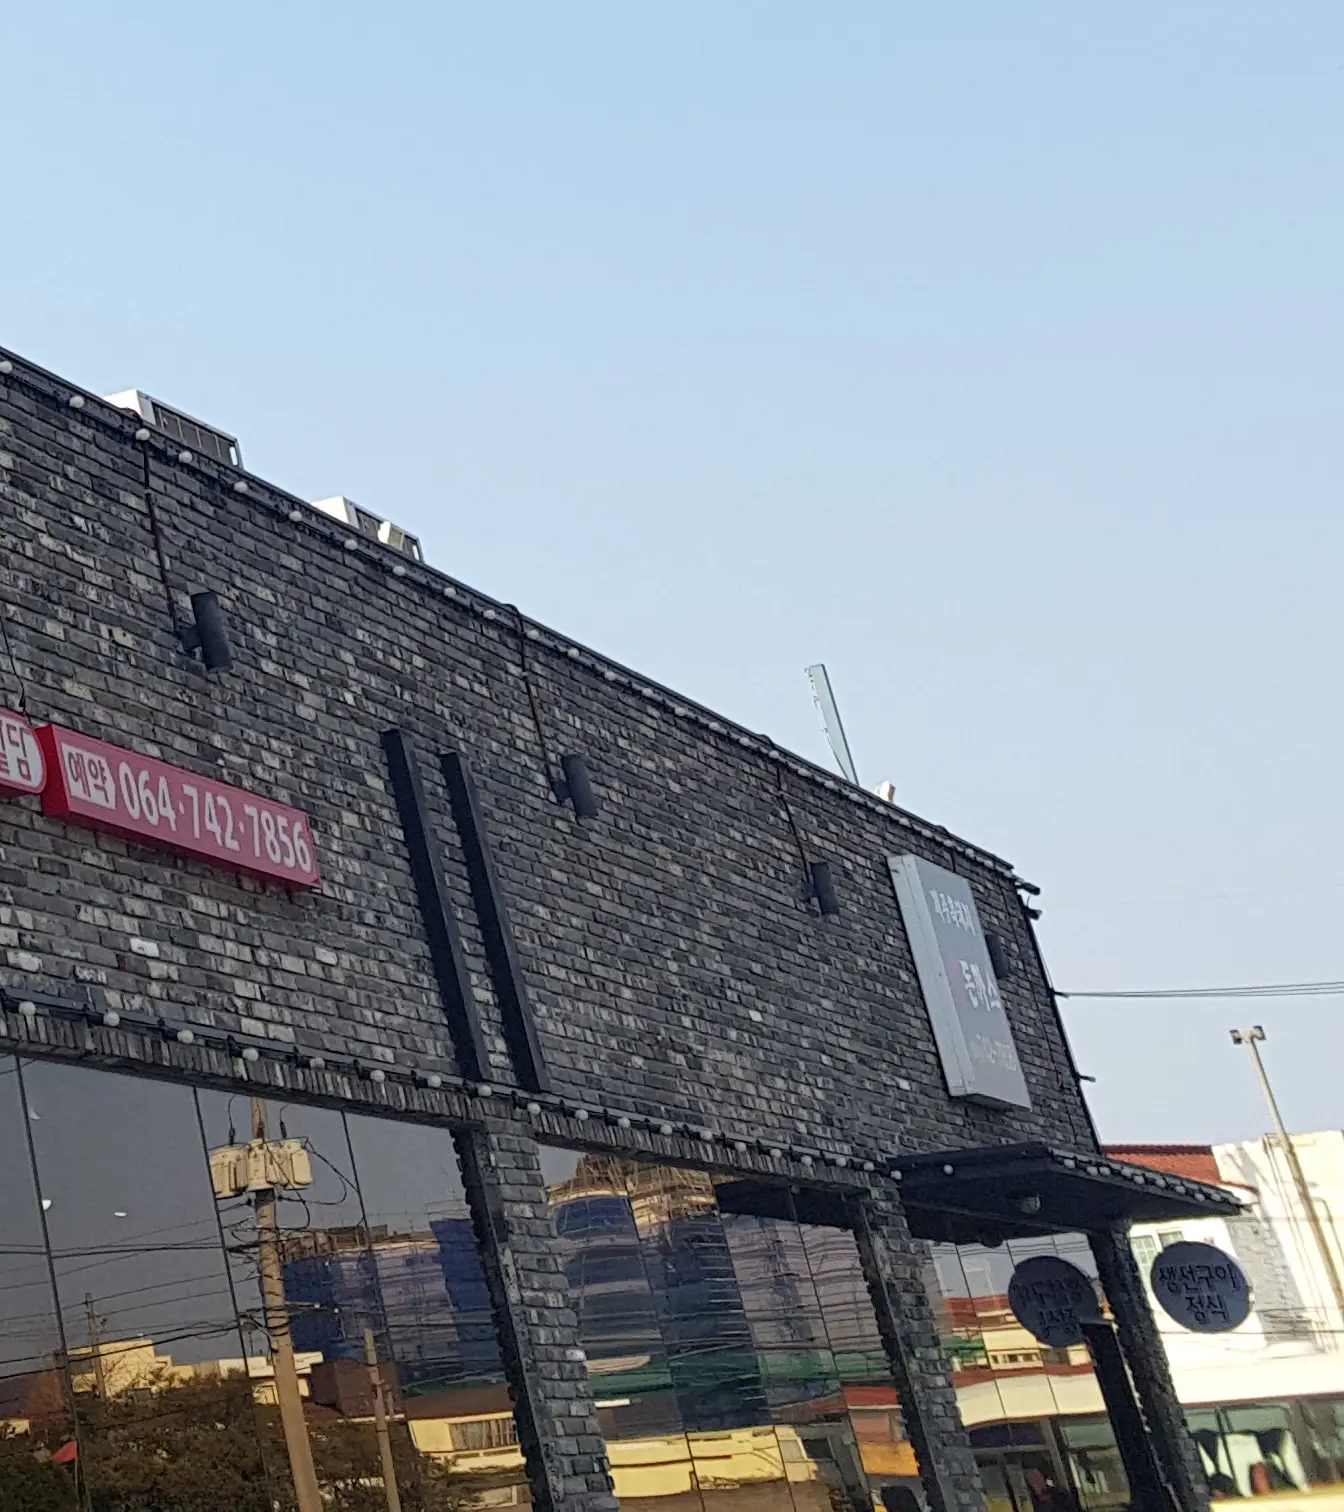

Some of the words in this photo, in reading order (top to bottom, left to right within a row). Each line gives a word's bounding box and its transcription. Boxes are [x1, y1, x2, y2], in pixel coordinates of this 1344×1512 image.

[67, 750, 110, 804] 예약
[1158, 1262, 1239, 1293] 생선구이
[1185, 1294, 1229, 1323] 정식
